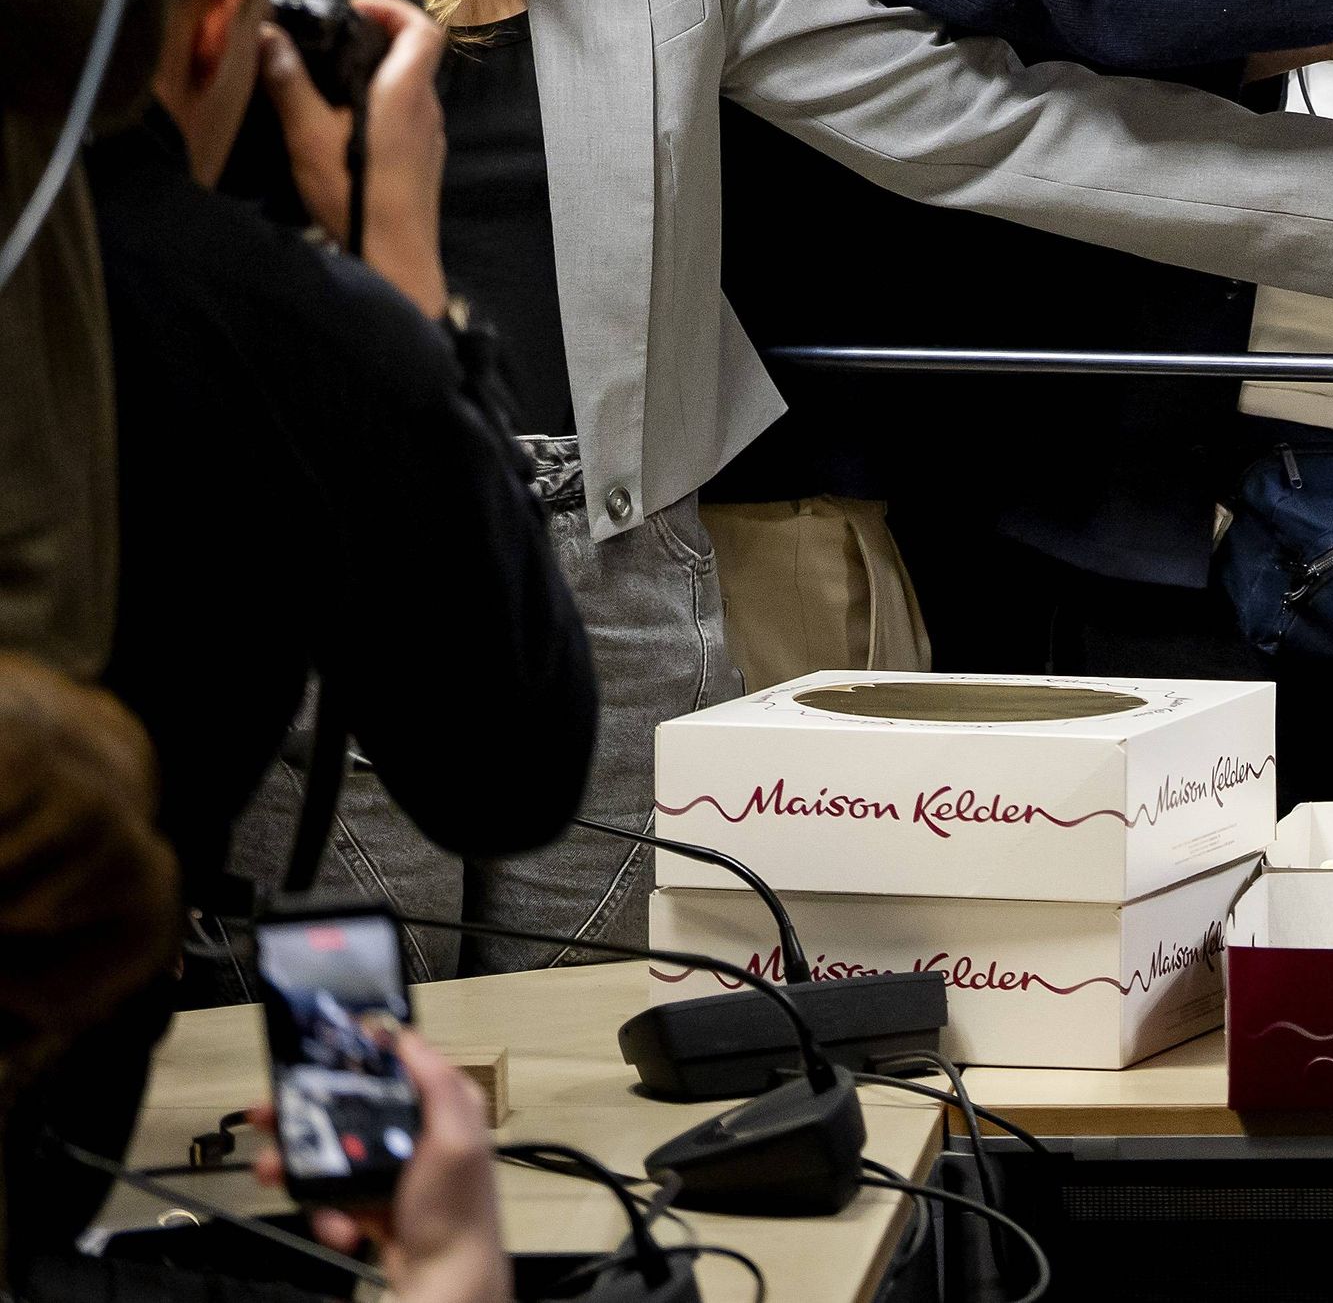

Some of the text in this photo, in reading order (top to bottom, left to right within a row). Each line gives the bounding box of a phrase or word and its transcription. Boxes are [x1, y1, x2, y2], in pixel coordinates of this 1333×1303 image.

[744, 778, 900, 820] Maison
[1156, 774, 1208, 813] Maison
[1150, 941, 1200, 979] Maison
